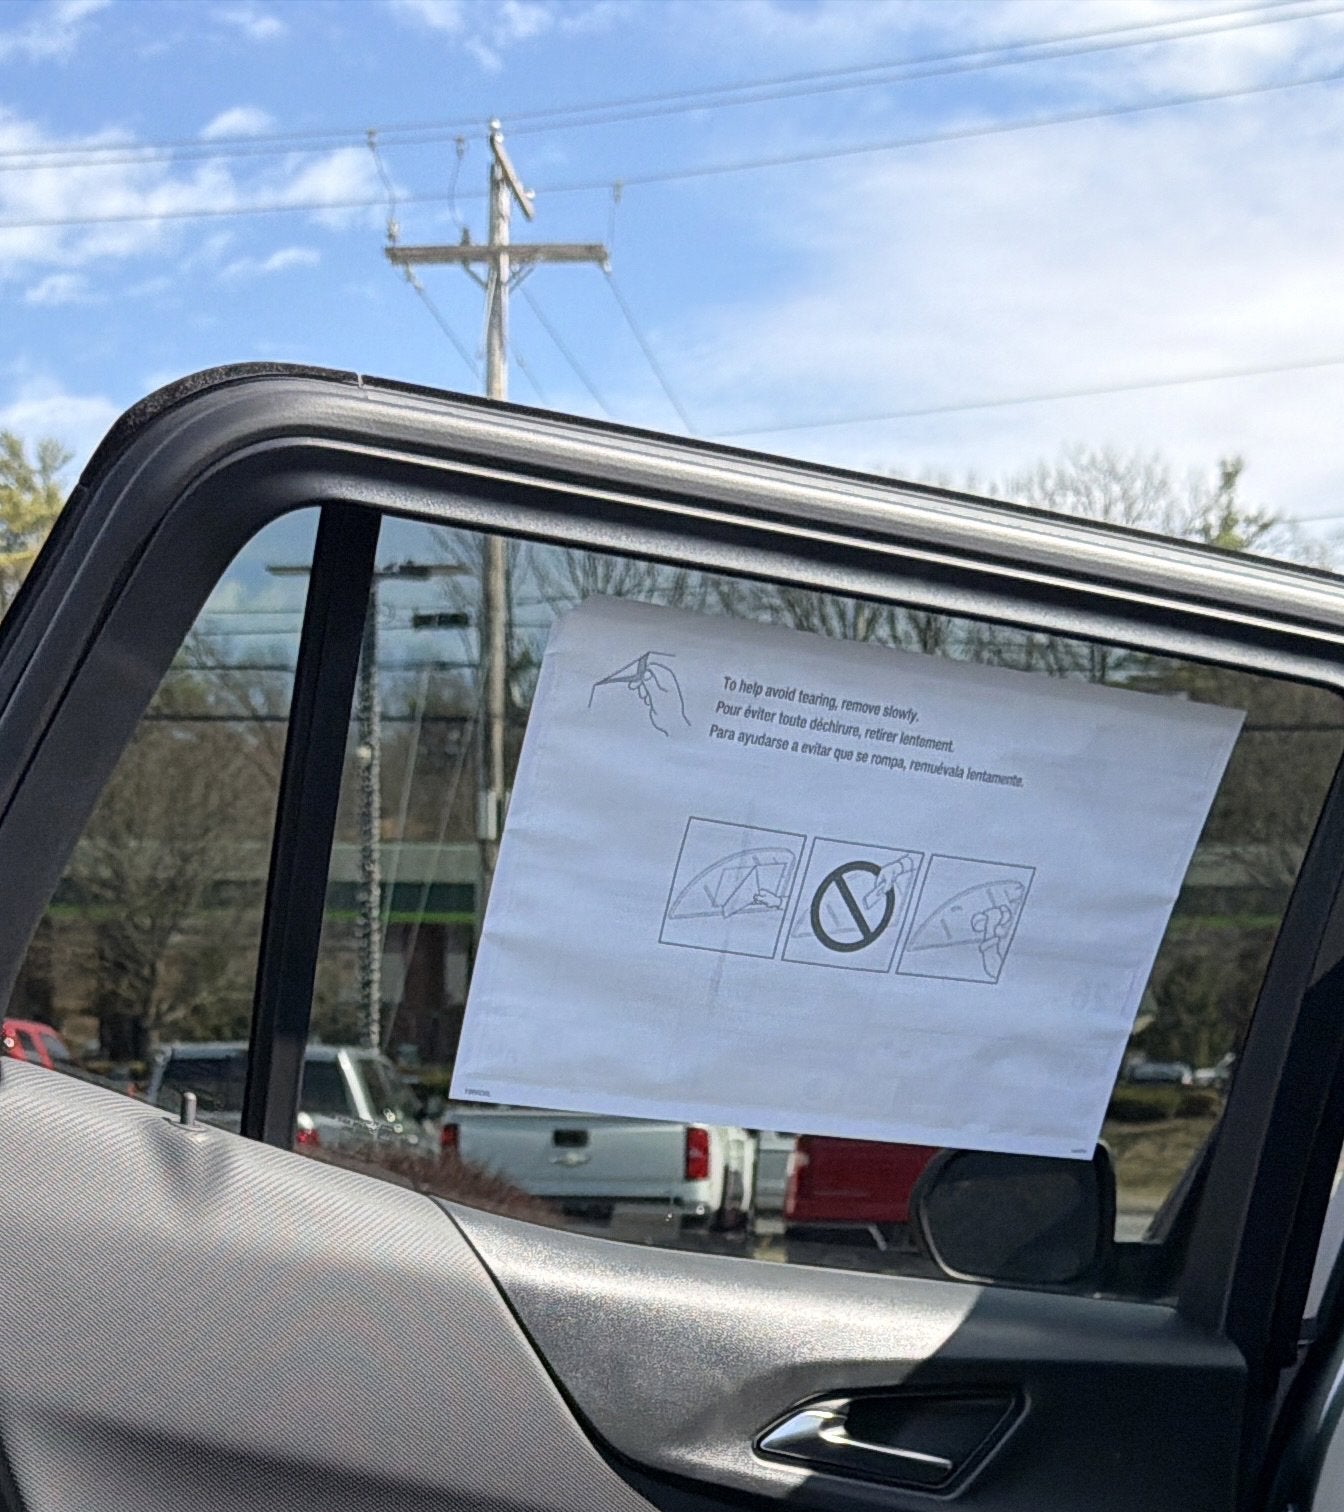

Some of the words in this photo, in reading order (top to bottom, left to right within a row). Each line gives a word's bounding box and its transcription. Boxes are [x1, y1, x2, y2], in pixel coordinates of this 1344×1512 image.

[723, 676, 737, 691] To
[739, 681, 763, 696] help
[765, 685, 796, 701] avoid
[798, 690, 838, 711] tearing,
[841, 699, 881, 716] remove
[882, 705, 919, 725] slowly.
[716, 701, 742, 716] Pour
[744, 705, 777, 722] éviter
[778, 711, 807, 729] toute
[809, 718, 862, 739] déchirure,
[864, 727, 898, 744] retirer
[899, 732, 955, 753] lentement.
[709, 723, 735, 740] Para
[737, 732, 789, 751] ayudarse
[791, 741, 799, 752] a
[801, 742, 832, 757] evitar
[833, 748, 854, 762] que
[855, 751, 869, 763] se
[870, 753, 907, 771] rompa,
[909, 759, 964, 780] remuévala
[966, 767, 1024, 788] lentamente.
